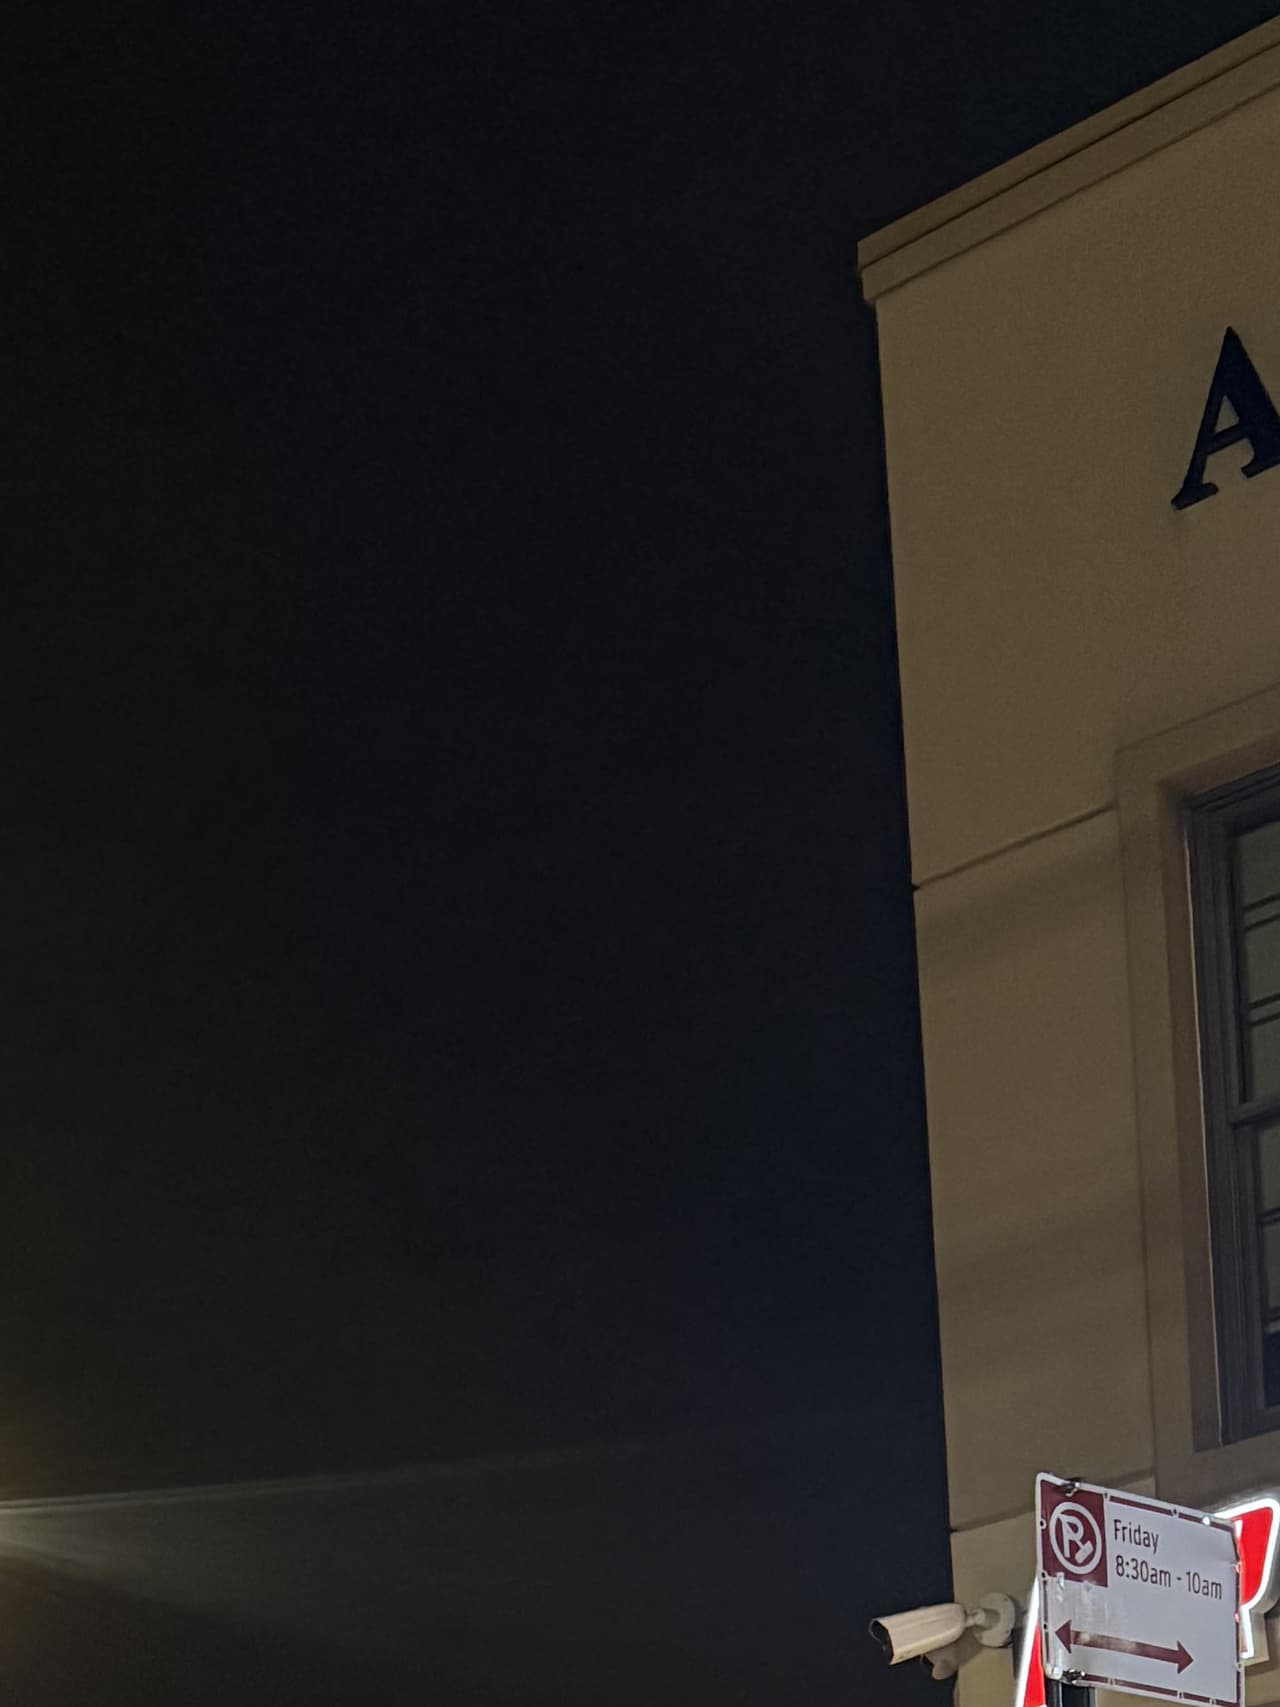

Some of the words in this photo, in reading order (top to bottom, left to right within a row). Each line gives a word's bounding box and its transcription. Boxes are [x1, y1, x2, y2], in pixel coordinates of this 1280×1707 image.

[1112, 1519, 1160, 1555] Friday
[1115, 1555, 1173, 1589] 8:30am
[1185, 1571, 1223, 1601] 10am
